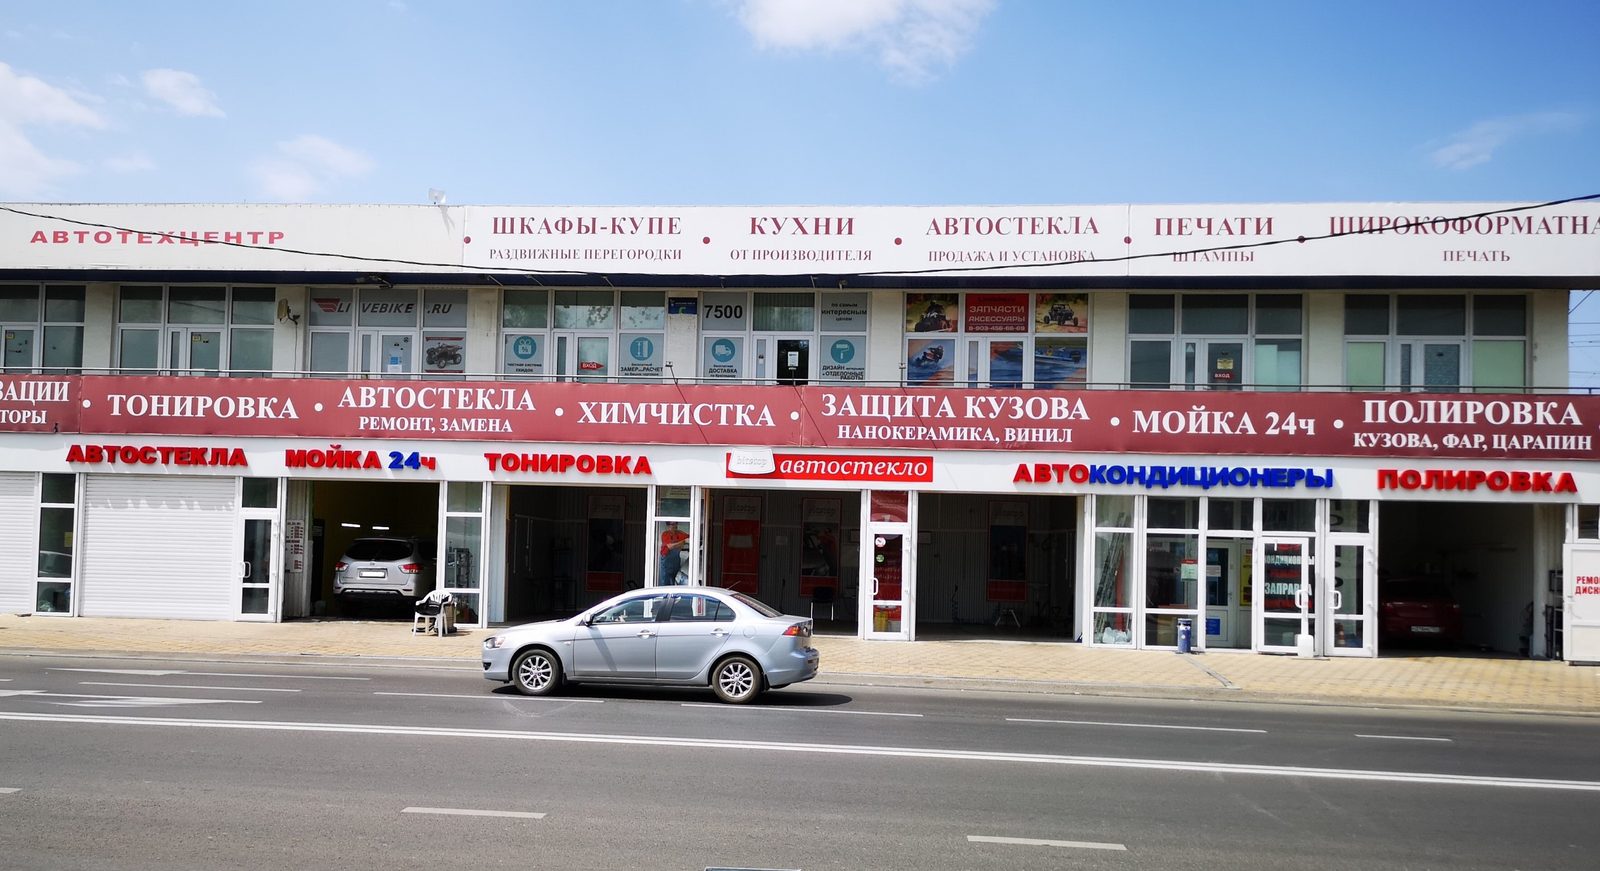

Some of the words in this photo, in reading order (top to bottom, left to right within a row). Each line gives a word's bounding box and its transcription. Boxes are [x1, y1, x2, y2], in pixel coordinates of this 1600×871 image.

[492, 216, 682, 236] ШКАФЫ-КУПЕ
[750, 217, 855, 236] КУХНИ
[926, 216, 1099, 236] АВТОСТЕКЛА
[1155, 216, 1274, 237] ПЕЧАТИ
[30, 230, 285, 247] АВТОТЕХЦЕНТР
[489, 248, 582, 262] РАЗДВИЖНЫЕ
[584, 248, 682, 262] ПЕРЕГОРОДКИ
[730, 249, 750, 261] ОТ
[752, 248, 873, 263] ПРОИЗВОДИТЕЛЯ
[928, 250, 995, 264] ПРОДАЖА
[998, 251, 1008, 262] И
[1011, 250, 1096, 263] УСТАНОВКА
[1172, 250, 1255, 263] ШТАМПЫ
[1443, 249, 1511, 262] ПЕЧАТЬ
[427, 304, 452, 314] .RU
[704, 305, 743, 319] 7500
[969, 305, 1025, 313] ЗАПЧАСТИ
[0, 380, 71, 406] АЦИИ
[337, 386, 536, 413] АВТОСТЕКЛА
[106, 394, 299, 420] ТОНИРОВКА
[577, 401, 776, 428] ХИМЧИСТКА
[820, 393, 956, 420] ЗАЩИТА
[964, 395, 1090, 421] КУЗОВА
[1362, 399, 1582, 427] ПОЛИРОВКА
[358, 416, 437, 433] РЕМОНТ,
[440, 417, 513, 433] ЗАМЕНА
[1132, 405, 1256, 436] МОЙКА
[1266, 410, 1315, 436] 24ч
[836, 424, 1000, 443] НАНОКЕРАМИКА,
[1004, 427, 1073, 444] ВИНИЛ
[1353, 432, 1438, 450] КУЗОВА,
[1442, 433, 1488, 450] ФАР,
[1492, 433, 1592, 451] ЦАРАПИН
[66, 444, 248, 467] АВТОСТЕКЛА
[285, 444, 383, 470] МОЙКА
[388, 451, 437, 471] 24ч
[484, 452, 653, 475] ТОНИРОВКА
[779, 458, 928, 477] автостекло
[1013, 462, 1335, 490] АВТОКОНДИЦИОНЕРЫ
[1377, 468, 1578, 494] ПОЛИРОВКА
[1576, 575, 1600, 585] РЕМО
[1575, 585, 1600, 596] ДИСК
